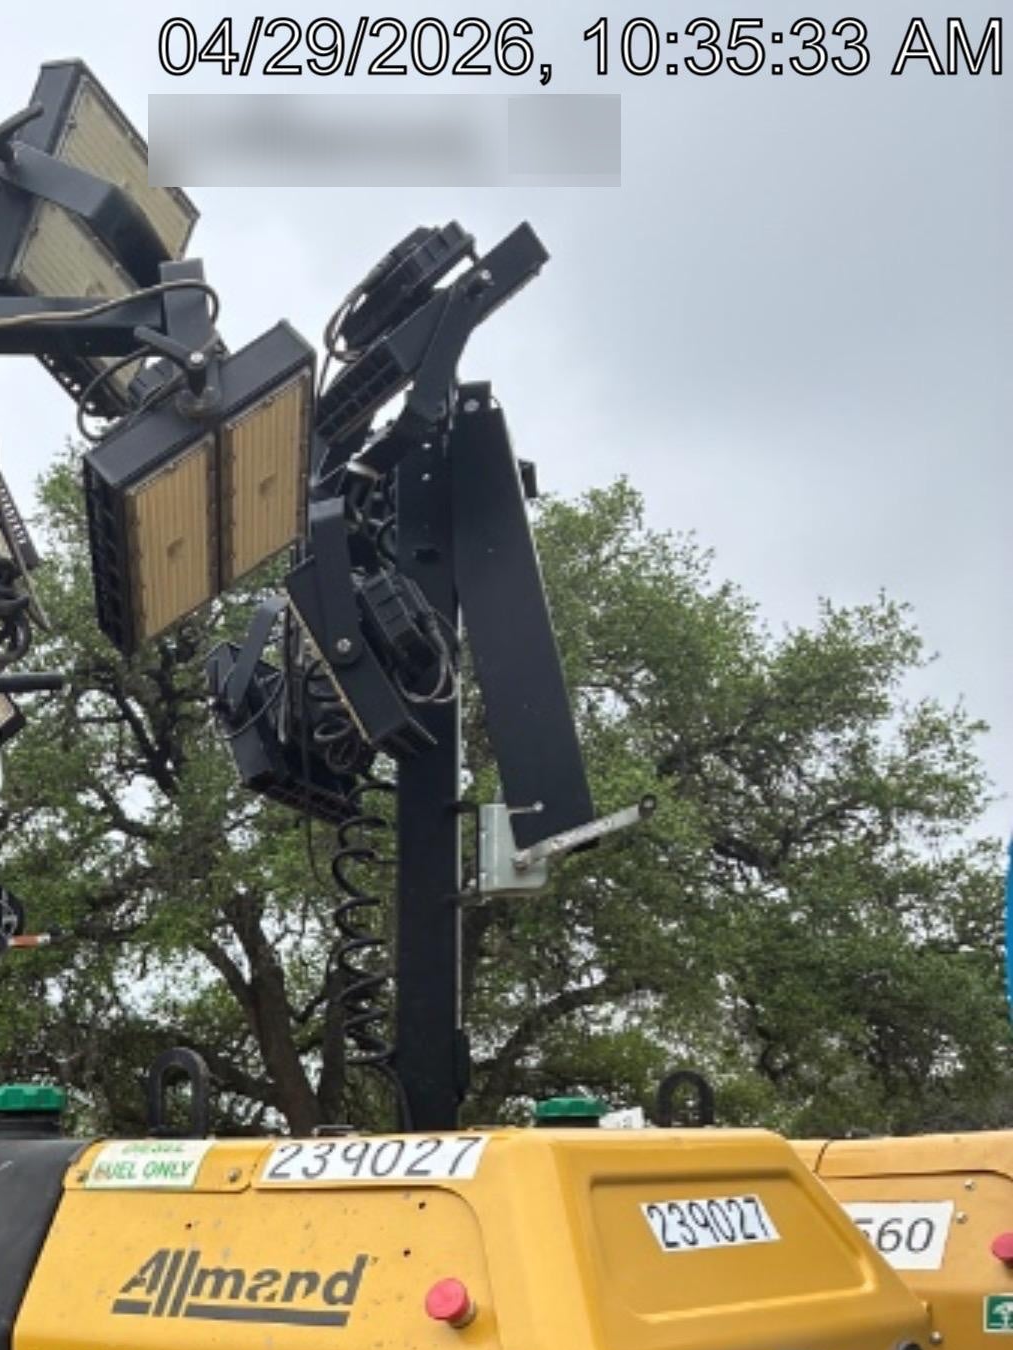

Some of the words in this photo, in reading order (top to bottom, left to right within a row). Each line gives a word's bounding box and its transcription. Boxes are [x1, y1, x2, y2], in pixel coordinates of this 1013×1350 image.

[93, 1161, 138, 1180] FUEL
[142, 1160, 194, 1179] ONLY
[268, 1136, 483, 1179] 239027
[646, 1196, 772, 1248] 239027
[118, 1247, 370, 1319] Allmand
